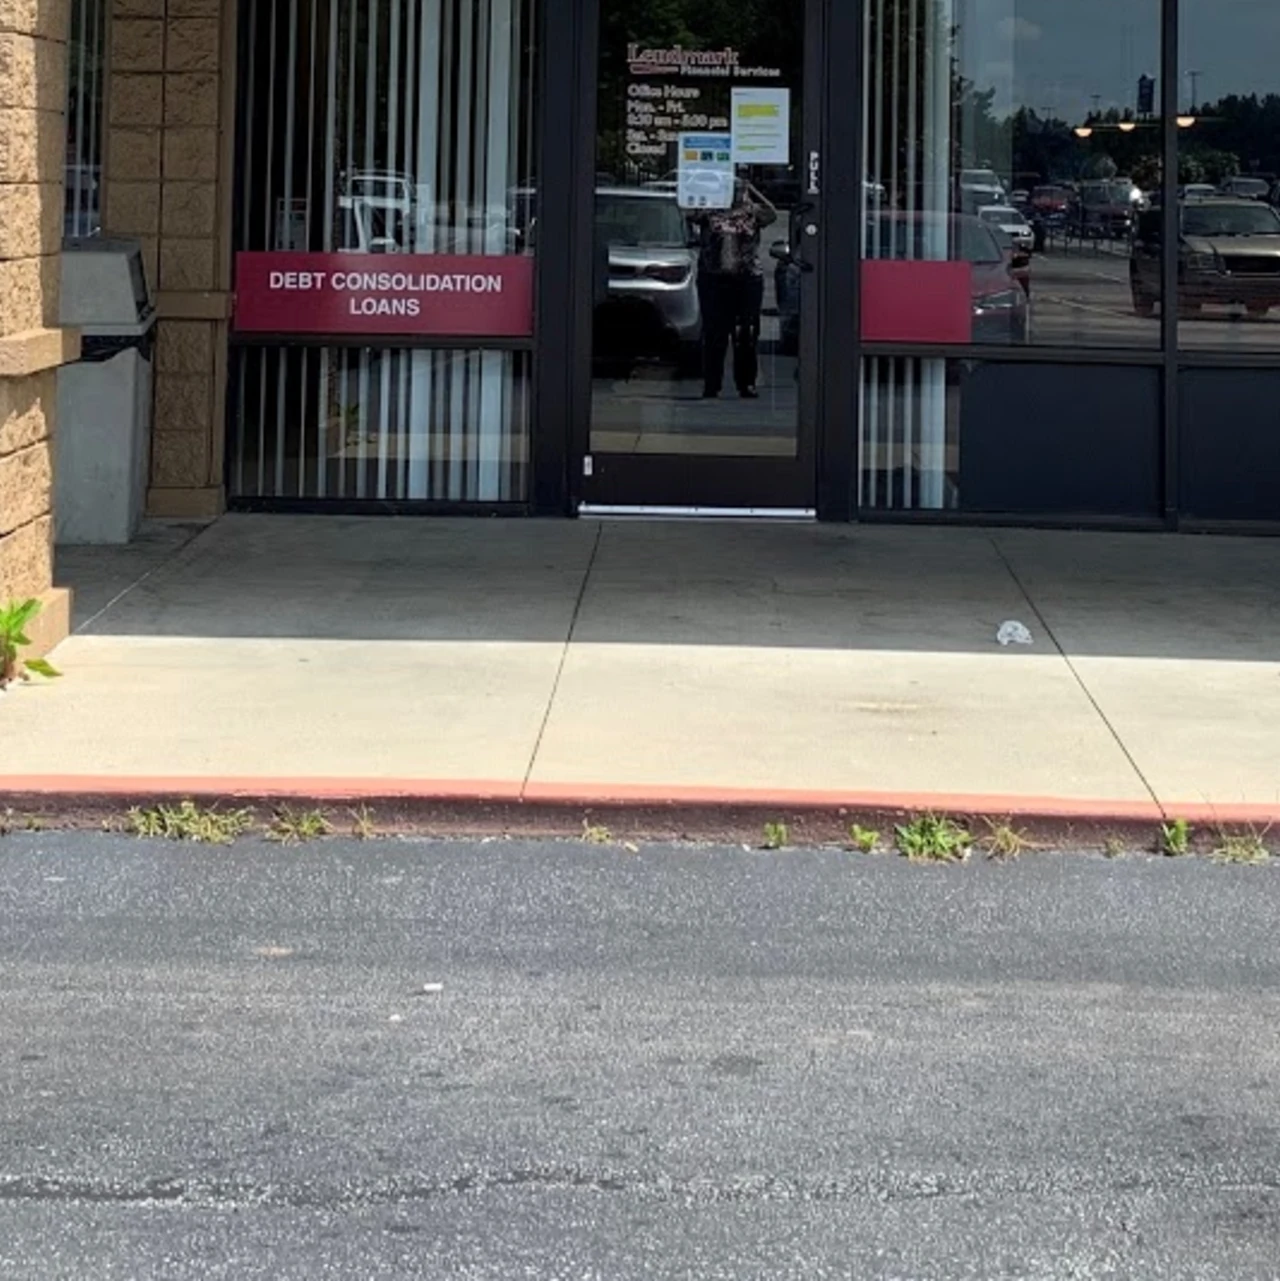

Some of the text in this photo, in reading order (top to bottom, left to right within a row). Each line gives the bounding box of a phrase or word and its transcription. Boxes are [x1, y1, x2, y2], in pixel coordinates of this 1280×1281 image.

[270, 272, 502, 293] DEBT CONSOLIDATION
[349, 297, 420, 316] LOANS
